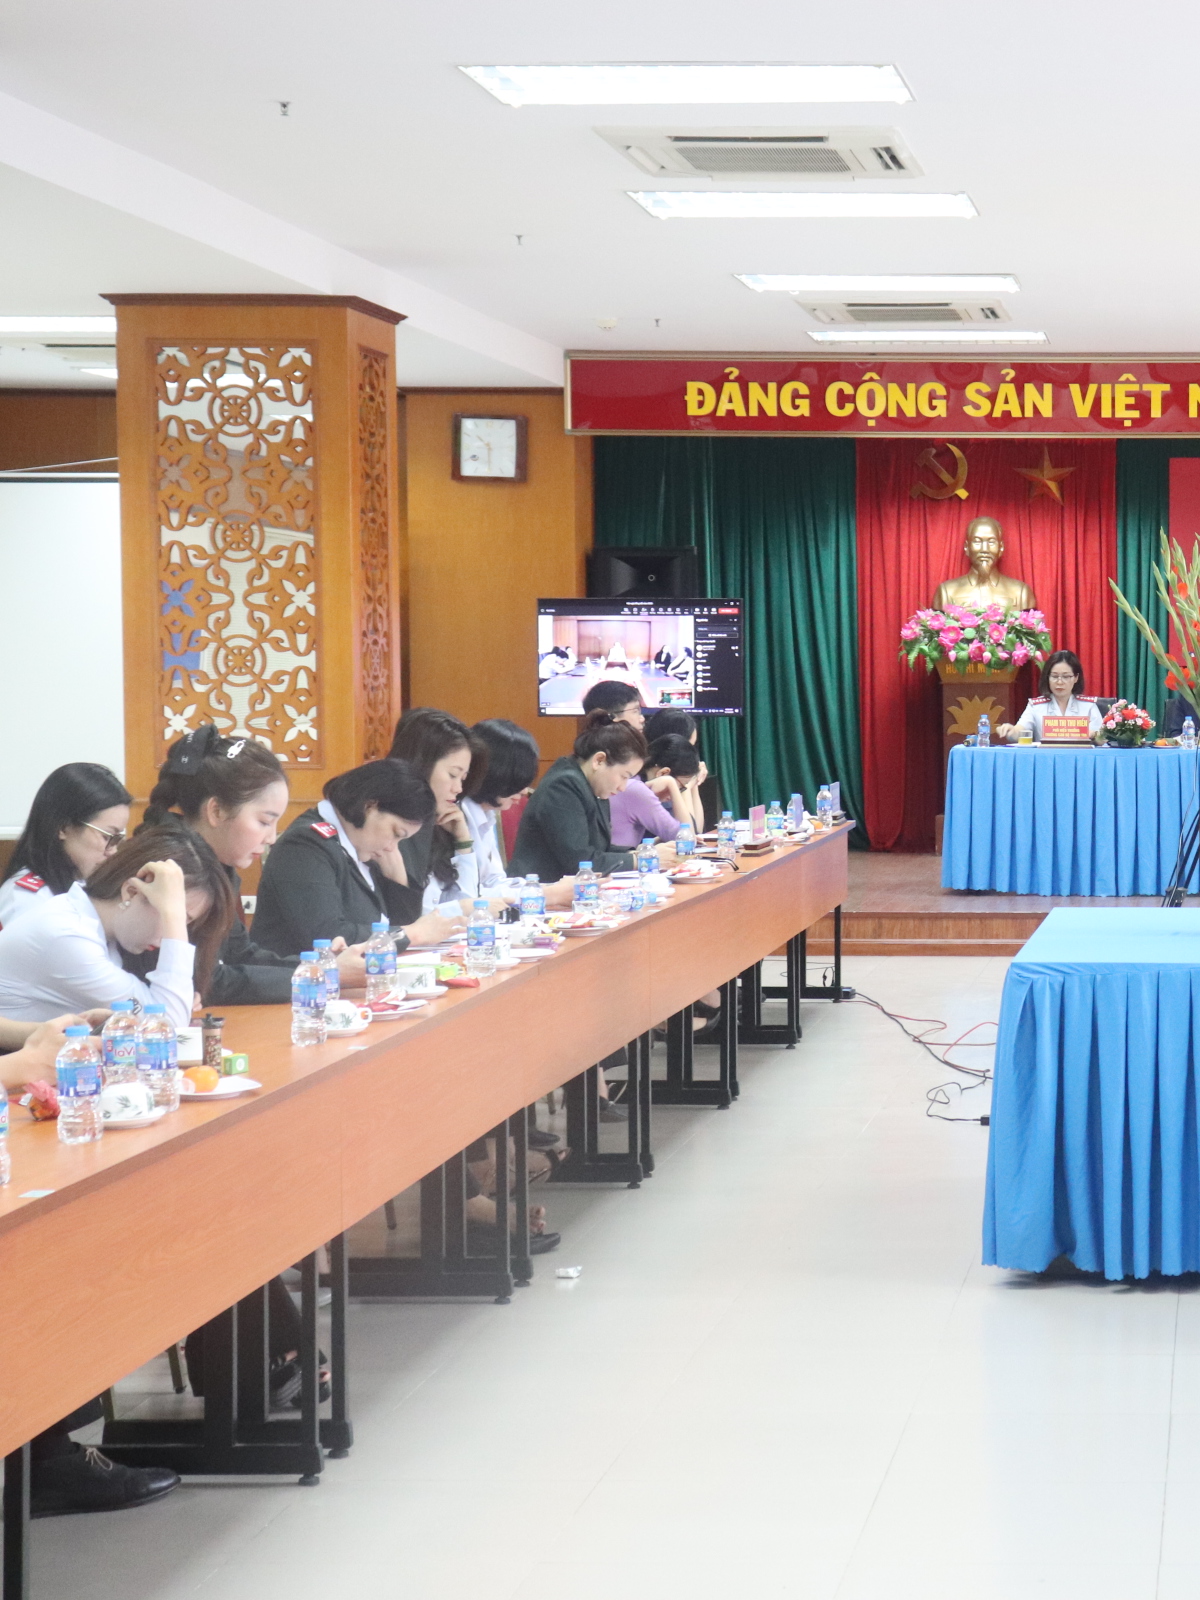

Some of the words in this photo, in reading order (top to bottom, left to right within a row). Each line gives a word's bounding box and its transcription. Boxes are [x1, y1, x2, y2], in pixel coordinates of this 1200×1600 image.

[685, 366, 810, 417] ĐẢNG
[826, 371, 947, 427] CỘNG
[963, 367, 1053, 418] SẢN
[1069, 372, 1170, 427] VIỆT
[114, 1046, 136, 1058] laVi
